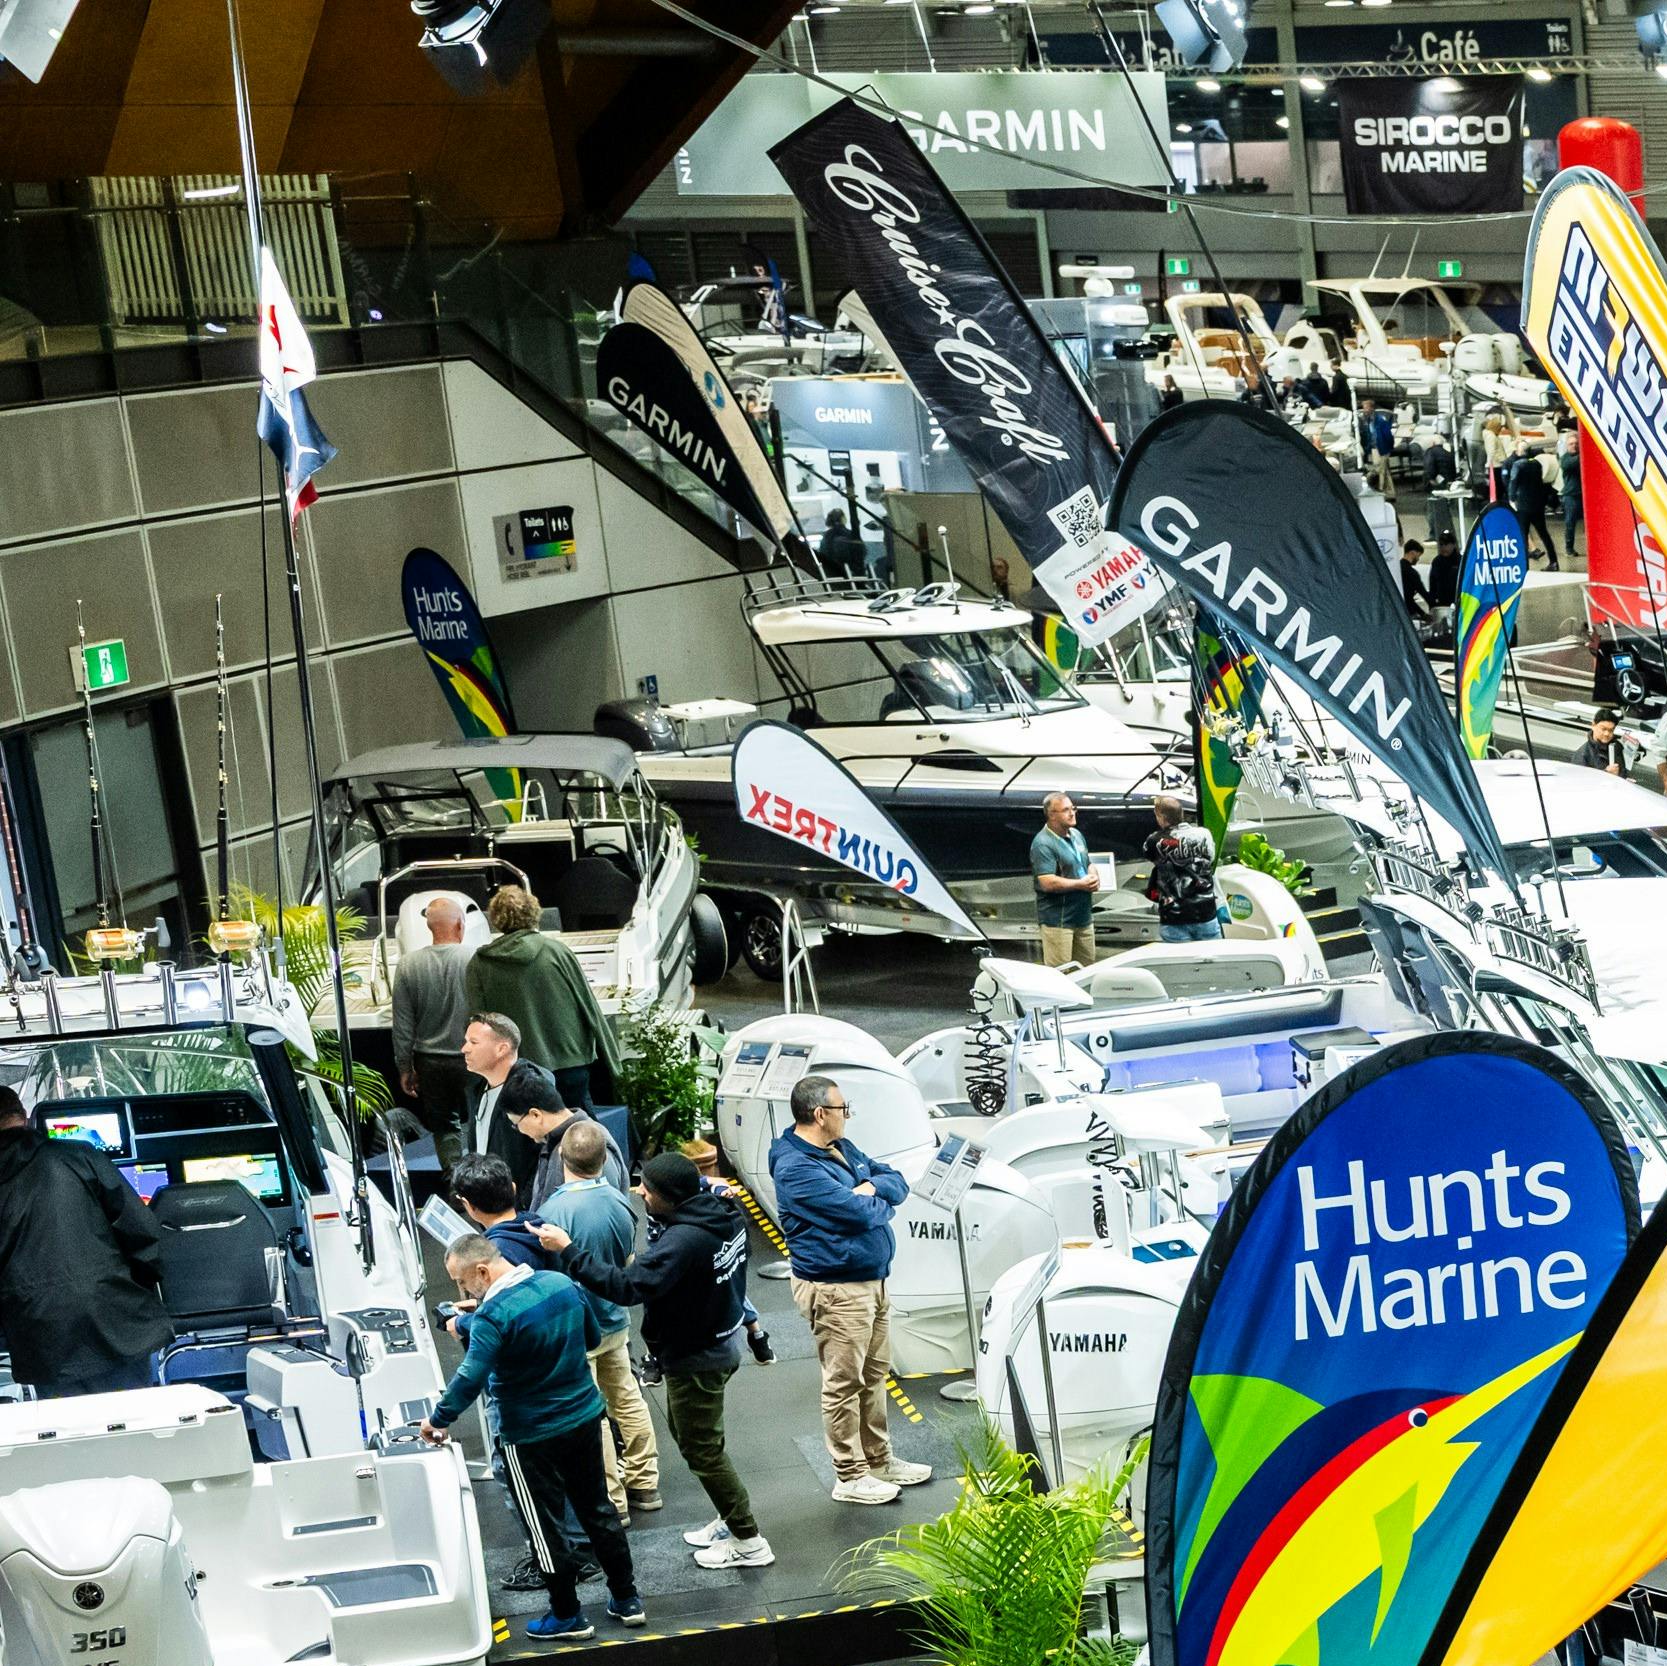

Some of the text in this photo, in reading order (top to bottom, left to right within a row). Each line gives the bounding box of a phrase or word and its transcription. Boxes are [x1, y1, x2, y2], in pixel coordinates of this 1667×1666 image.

[1421, 30, 1480, 63] Café
[1354, 116, 1511, 146] SIROCCO
[1381, 150, 1487, 173] MARINE
[825, 144, 1070, 464] Cruise Craft
[607, 376, 727, 482] GARMIN
[815, 406, 872, 424] GARMIN
[1475, 533, 1519, 561] Hunts
[1091, 546, 1145, 590] YAMAH
[1474, 559, 1521, 586] Marine
[413, 587, 462, 612] Hunts
[1094, 583, 1128, 612] YMF
[417, 613, 468, 641] Marine
[1141, 495, 1412, 740] GARMIN
[1297, 1150, 1572, 1252] Hunts
[1293, 1237, 1587, 1342] Marine
[1049, 1333, 1129, 1353] YAMAHA
[70, 1625, 127, 1653] 350
